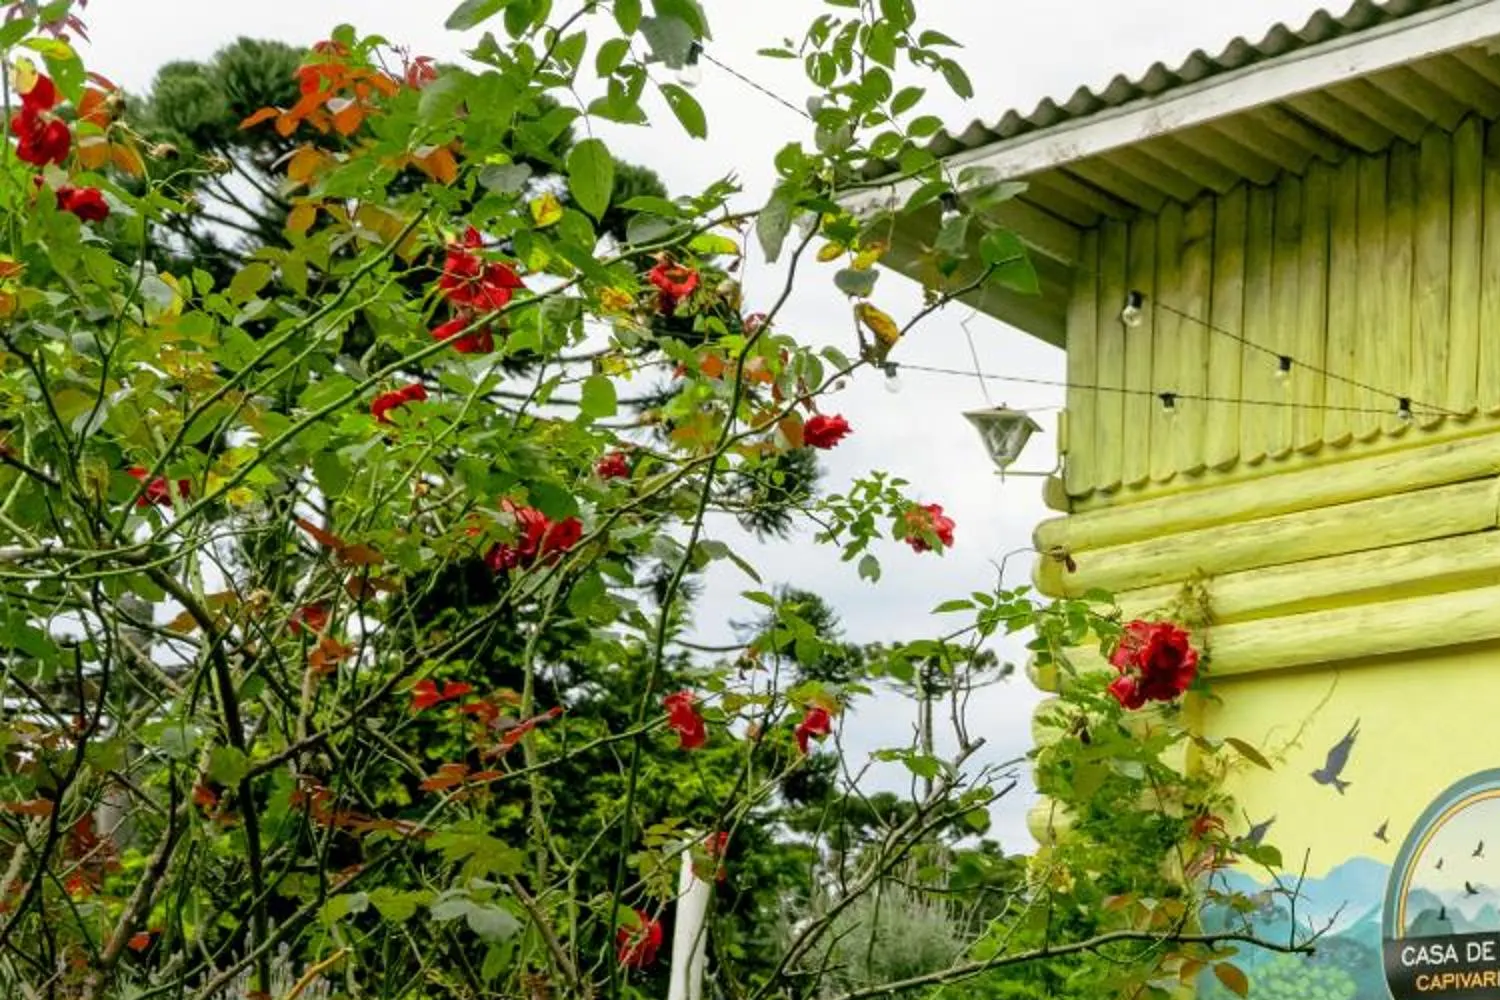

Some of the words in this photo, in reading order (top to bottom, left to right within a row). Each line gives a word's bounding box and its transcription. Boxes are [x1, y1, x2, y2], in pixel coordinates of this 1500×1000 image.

[1401, 943, 1459, 967] CASA
[1467, 941, 1495, 962] DE
[1416, 971, 1500, 991] CAPIVARI
